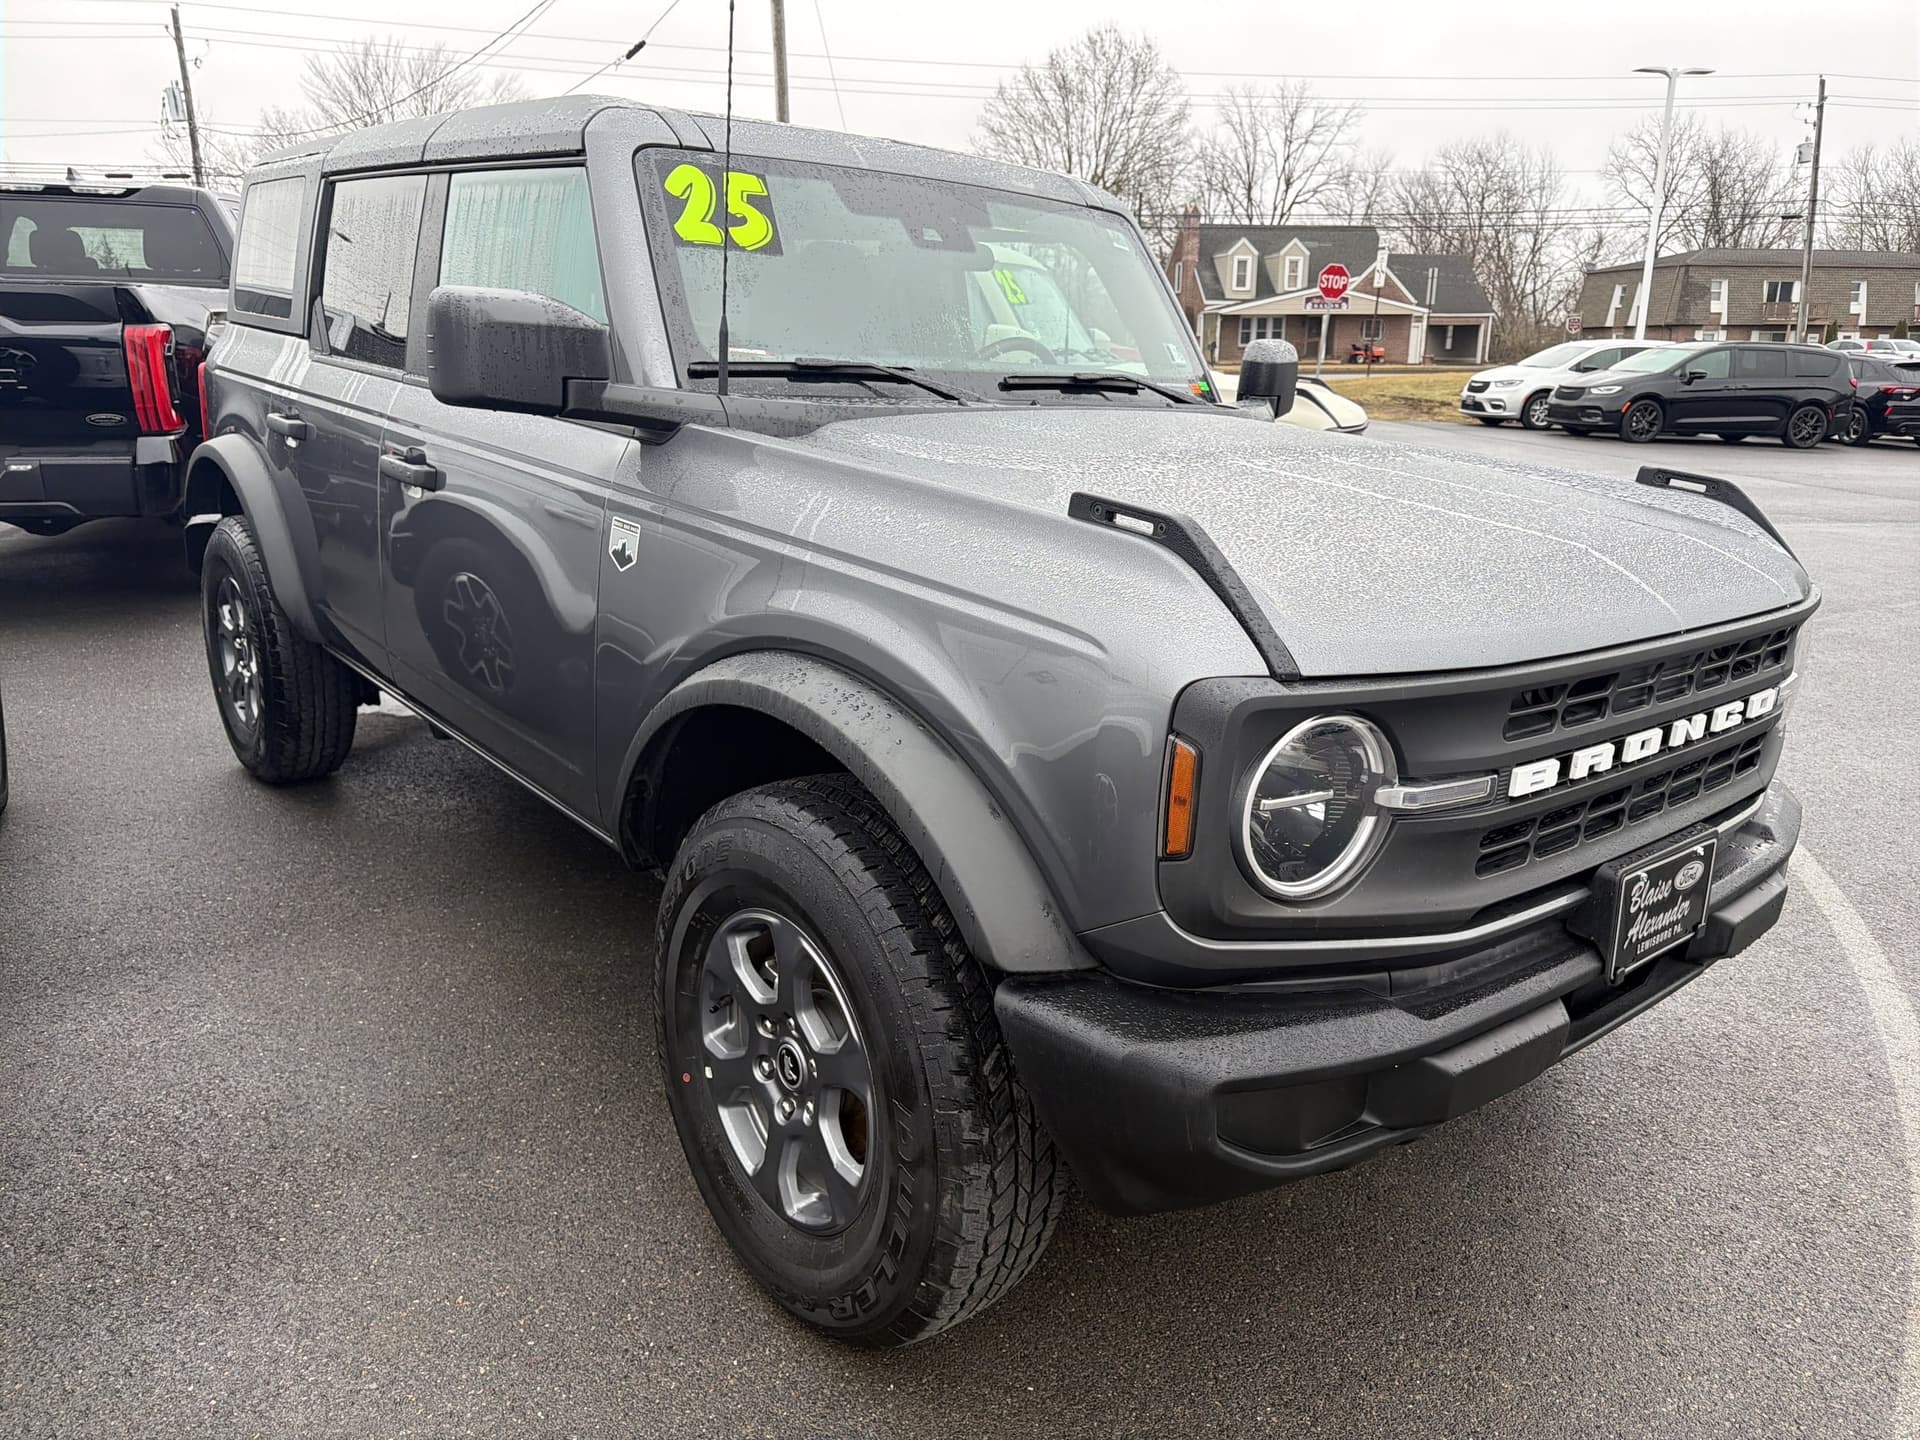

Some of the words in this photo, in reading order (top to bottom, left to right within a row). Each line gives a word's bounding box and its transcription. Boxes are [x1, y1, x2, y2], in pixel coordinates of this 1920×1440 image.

[664, 164, 773, 251] 25
[1320, 274, 1348, 289] STOP
[1508, 688, 1777, 798] BRONCO
[1630, 879, 1673, 914] Blaise
[1623, 895, 1691, 950] Alexander
[1636, 927, 1672, 954] LEWISBURG
